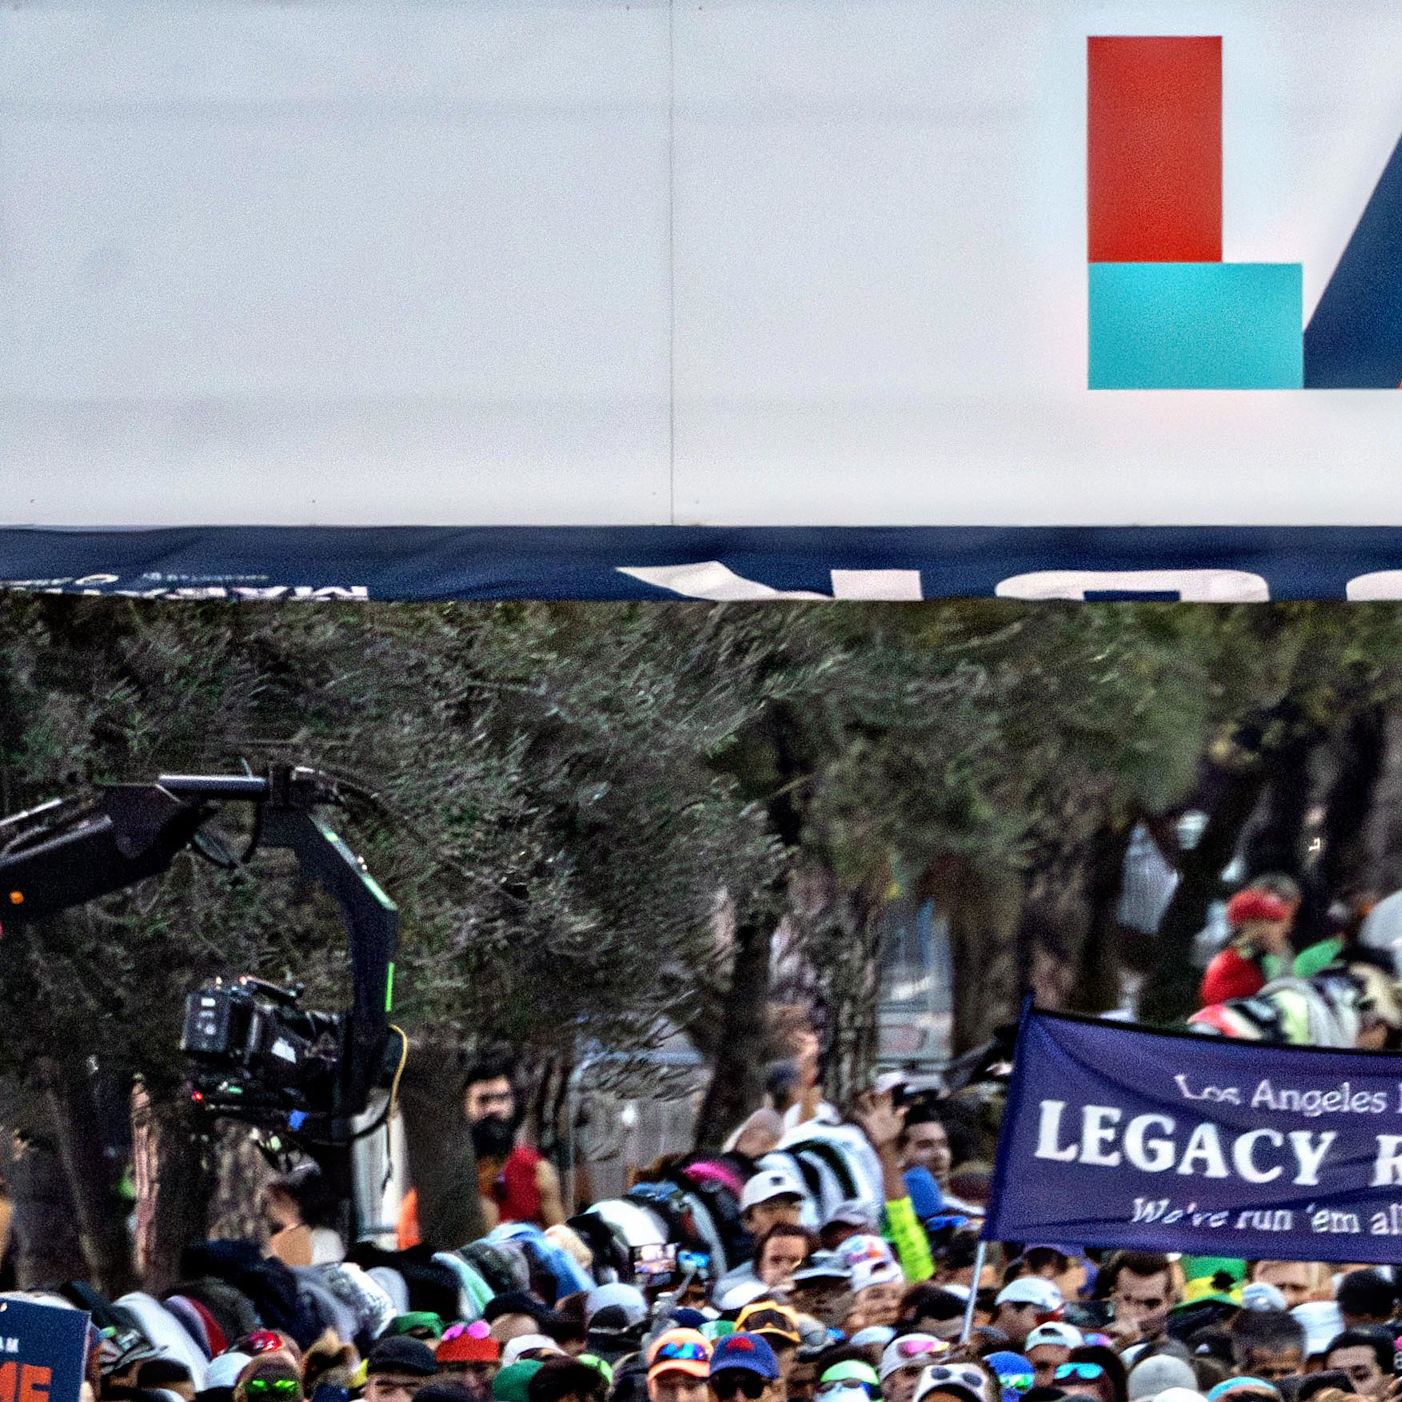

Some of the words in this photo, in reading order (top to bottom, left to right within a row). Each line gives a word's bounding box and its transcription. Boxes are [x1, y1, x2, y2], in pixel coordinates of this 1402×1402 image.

[1173, 1073, 1242, 1106] Los
[1251, 1078, 1388, 1118] Angeles
[1034, 1099, 1339, 1186] LEGACY
[1235, 1208, 1293, 1231] run
